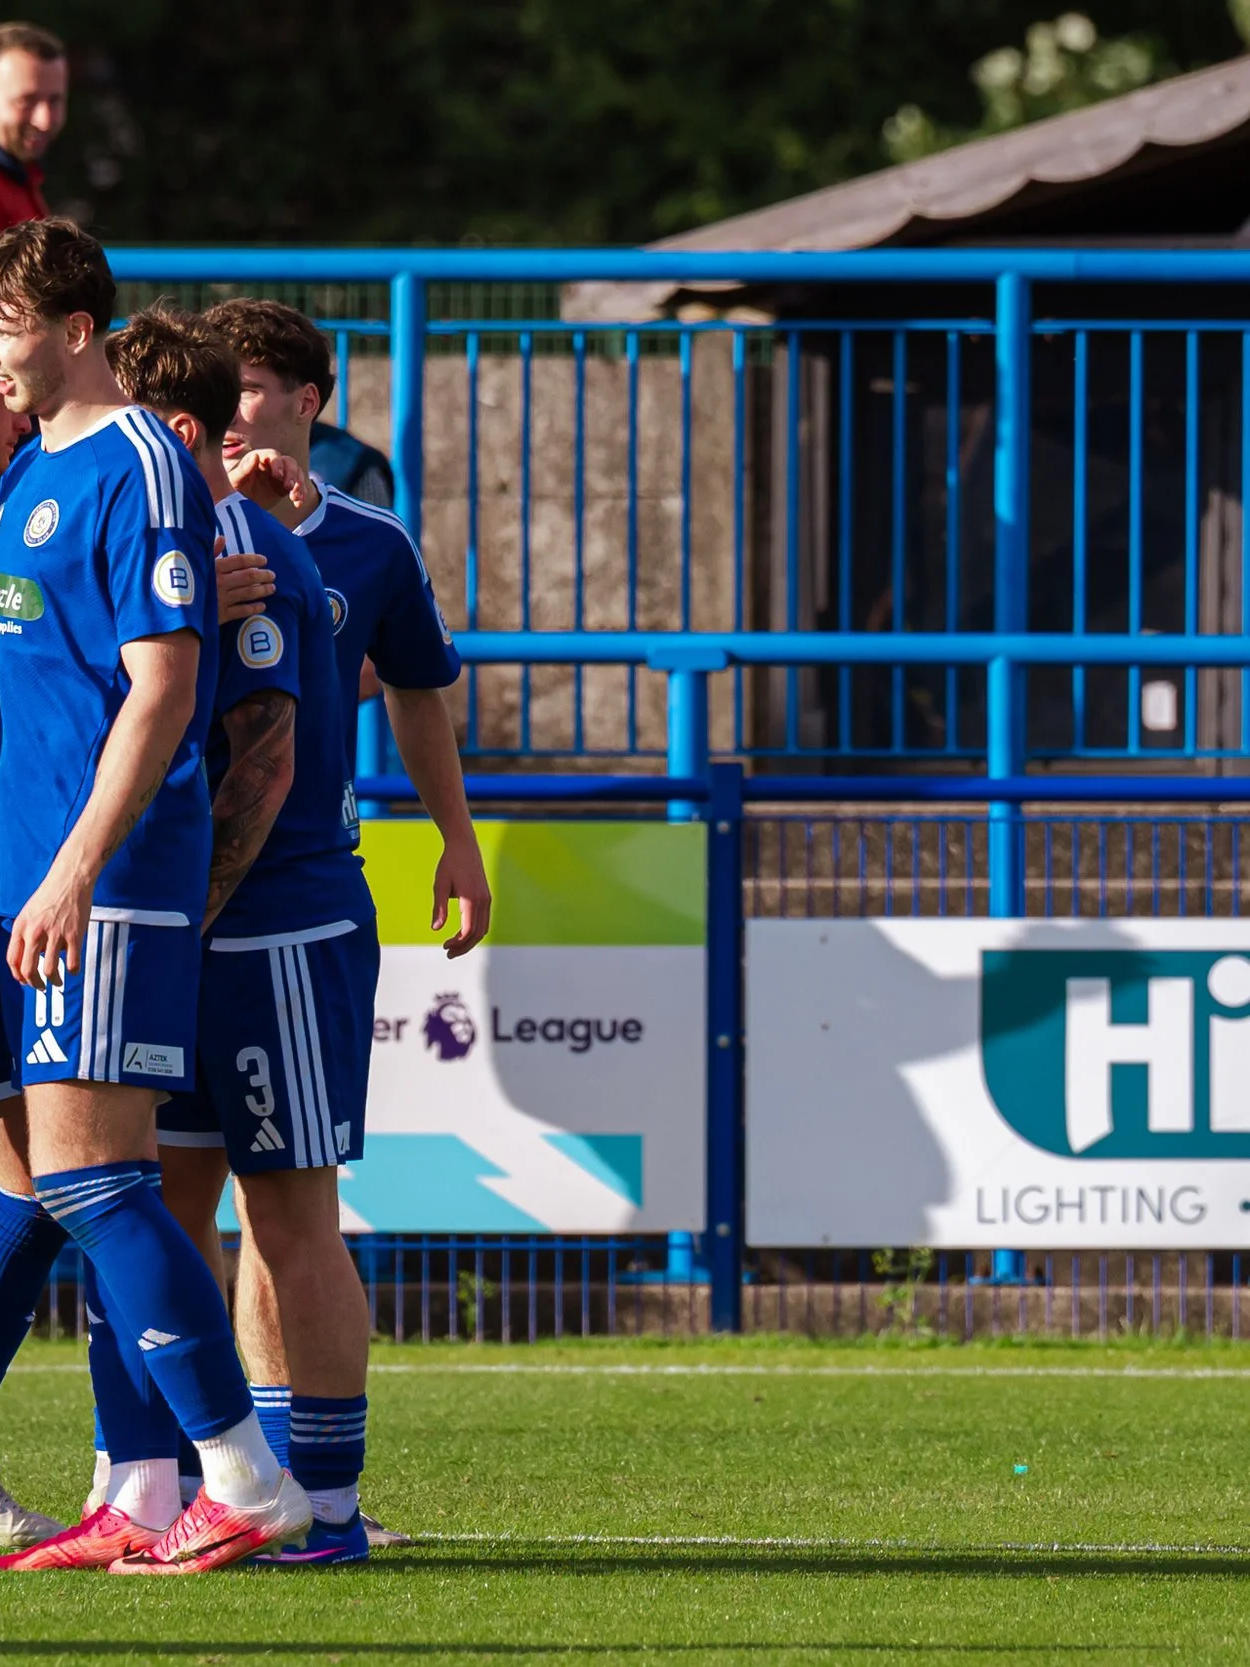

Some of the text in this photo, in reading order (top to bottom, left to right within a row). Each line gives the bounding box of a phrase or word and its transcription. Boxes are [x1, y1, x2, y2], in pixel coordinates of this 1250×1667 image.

[372, 1006, 644, 1054] er League
[236, 1046, 275, 1117] 3
[976, 1184, 1208, 1226] LIGHTING
